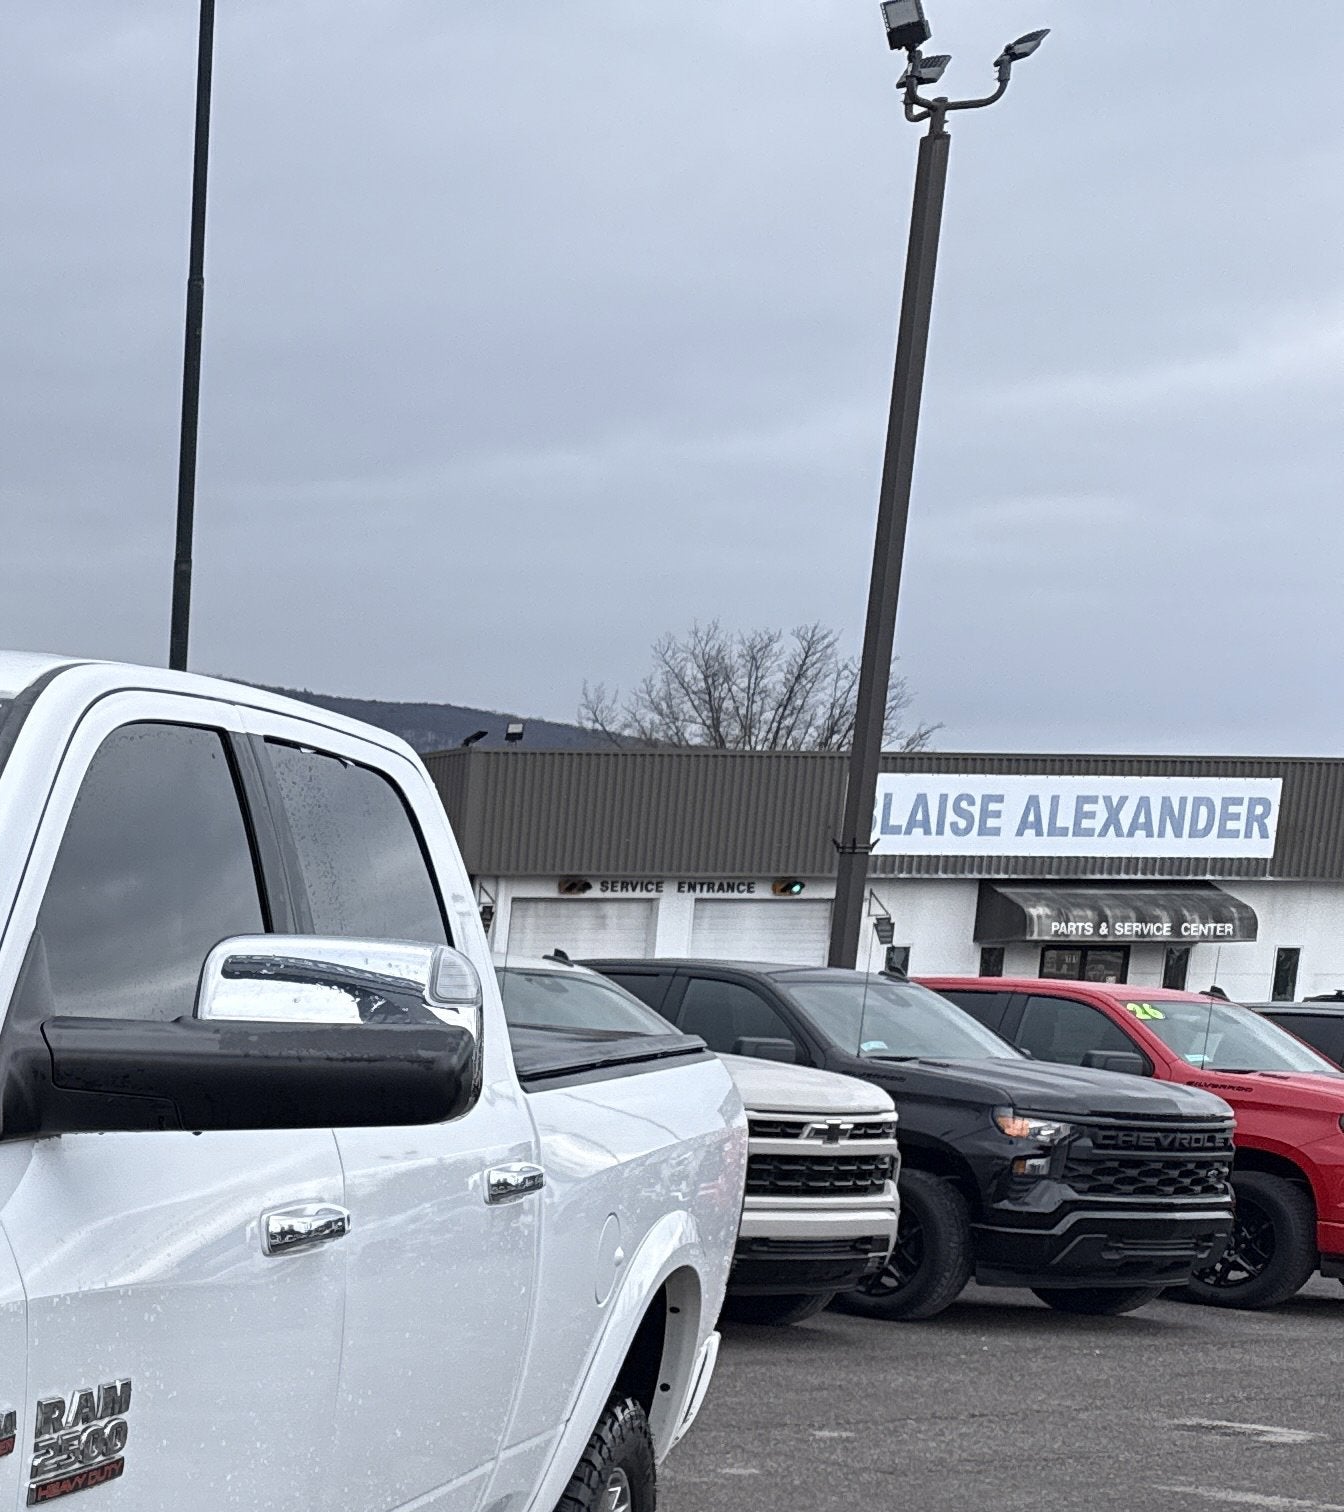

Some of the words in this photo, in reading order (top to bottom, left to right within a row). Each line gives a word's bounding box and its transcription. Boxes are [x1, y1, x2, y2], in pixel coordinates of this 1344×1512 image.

[872, 792, 1005, 837] LAISE
[1015, 795, 1273, 840] ALEXANDER
[599, 879, 665, 893] SERVICE
[676, 880, 756, 894] ENTRANCE
[1050, 921, 1094, 935] PARTS
[1099, 922, 1109, 936] &
[1114, 922, 1173, 936] SERVICE
[1181, 922, 1234, 936] CENTER
[1126, 1002, 1165, 1020] 26
[1185, 1080, 1254, 1093] SILVERADO
[1099, 1130, 1231, 1148] CHEVROLE
[35, 1378, 132, 1440] RAM
[30, 1417, 129, 1480] 2500
[37, 1475, 89, 1500] HEAVY
[88, 1461, 123, 1487] DUTY
